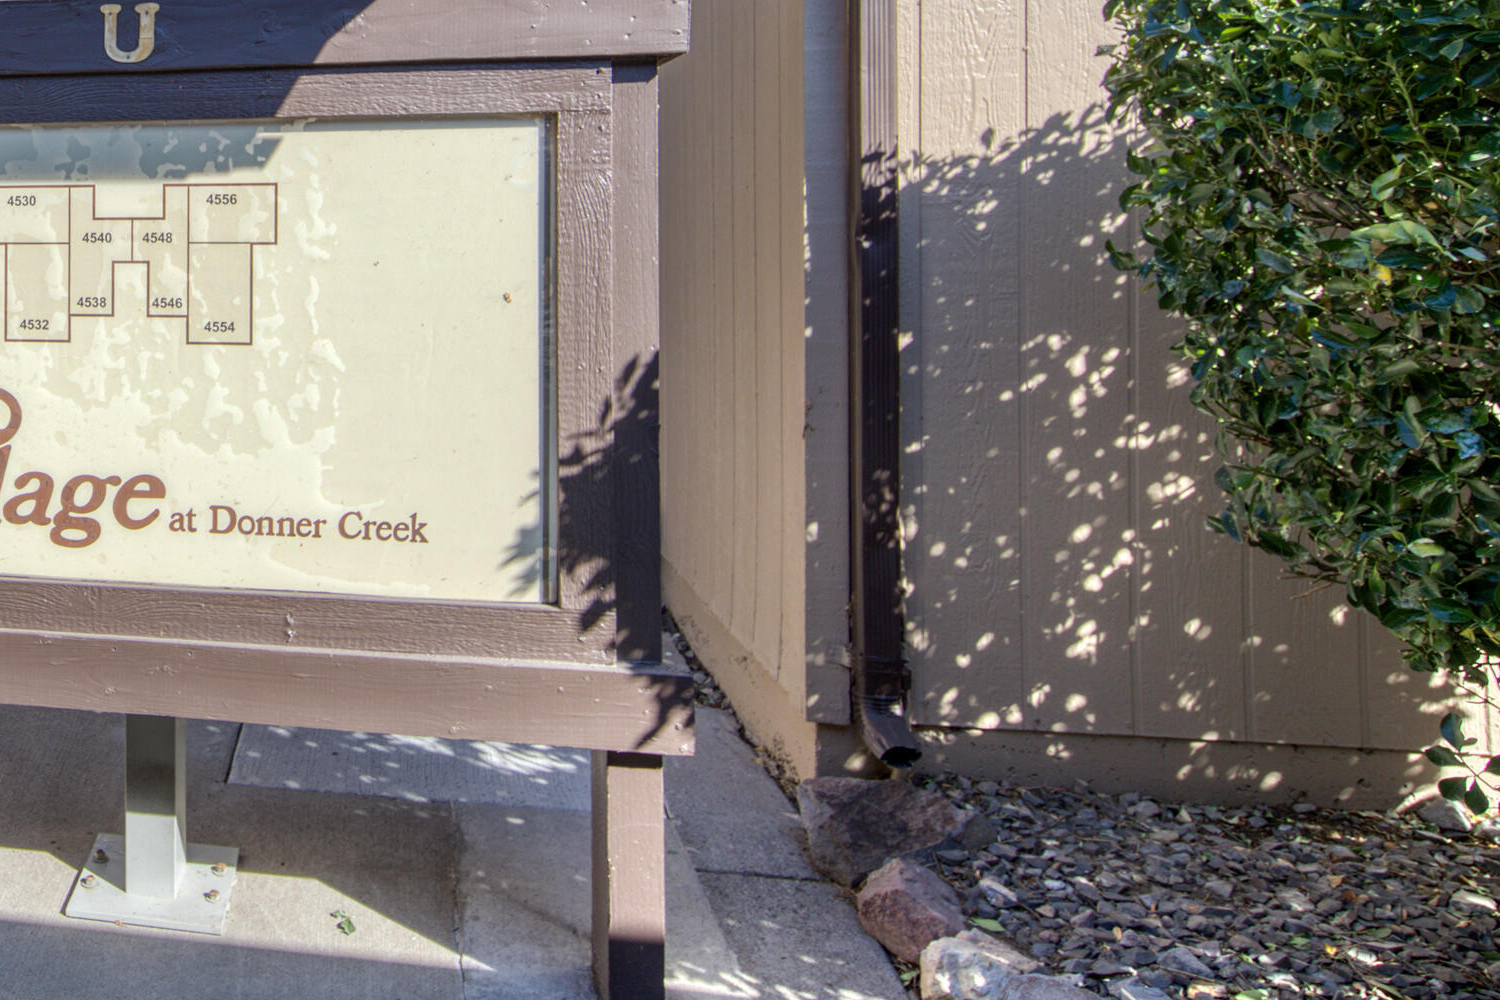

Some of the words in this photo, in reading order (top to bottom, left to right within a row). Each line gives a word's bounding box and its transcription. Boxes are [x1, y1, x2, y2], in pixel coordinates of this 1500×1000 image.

[100, 3, 160, 63] U
[7, 196, 37, 207] 4530
[206, 193, 238, 206] 4556
[82, 232, 113, 244] 4540
[142, 232, 173, 244] 4548
[76, 297, 107, 308] 4538
[152, 297, 183, 309] 4546
[19, 319, 49, 331] 4532
[204, 321, 236, 333] 4554
[168, 507, 198, 533] at
[208, 504, 328, 539] Donner
[338, 510, 430, 544] Creek
